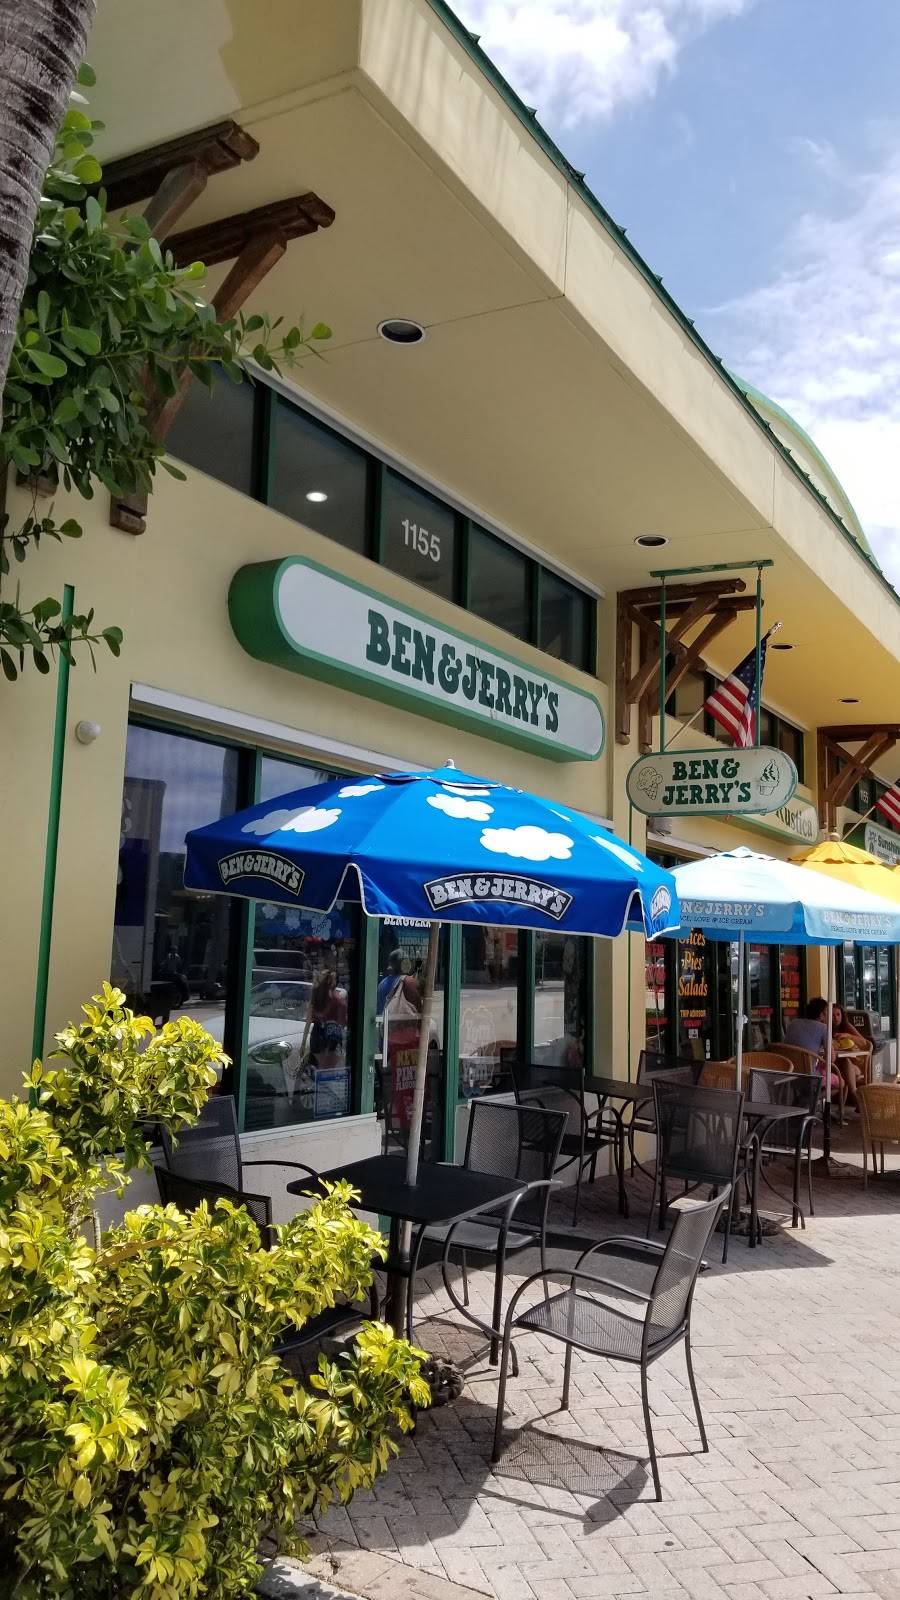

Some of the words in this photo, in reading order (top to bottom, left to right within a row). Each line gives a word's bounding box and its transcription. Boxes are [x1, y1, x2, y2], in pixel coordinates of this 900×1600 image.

[402, 519, 441, 562] 1155
[365, 608, 560, 733] BEN&JERRY'S
[672, 758, 740, 781] BEN&
[662, 780, 752, 805] JERRY'S
[220, 854, 301, 889] BEN&JERRY'S
[429, 877, 567, 913] BEN&JERRY'S
[680, 901, 765, 917] N&JERRY'S
[678, 975, 708, 997] Salads
